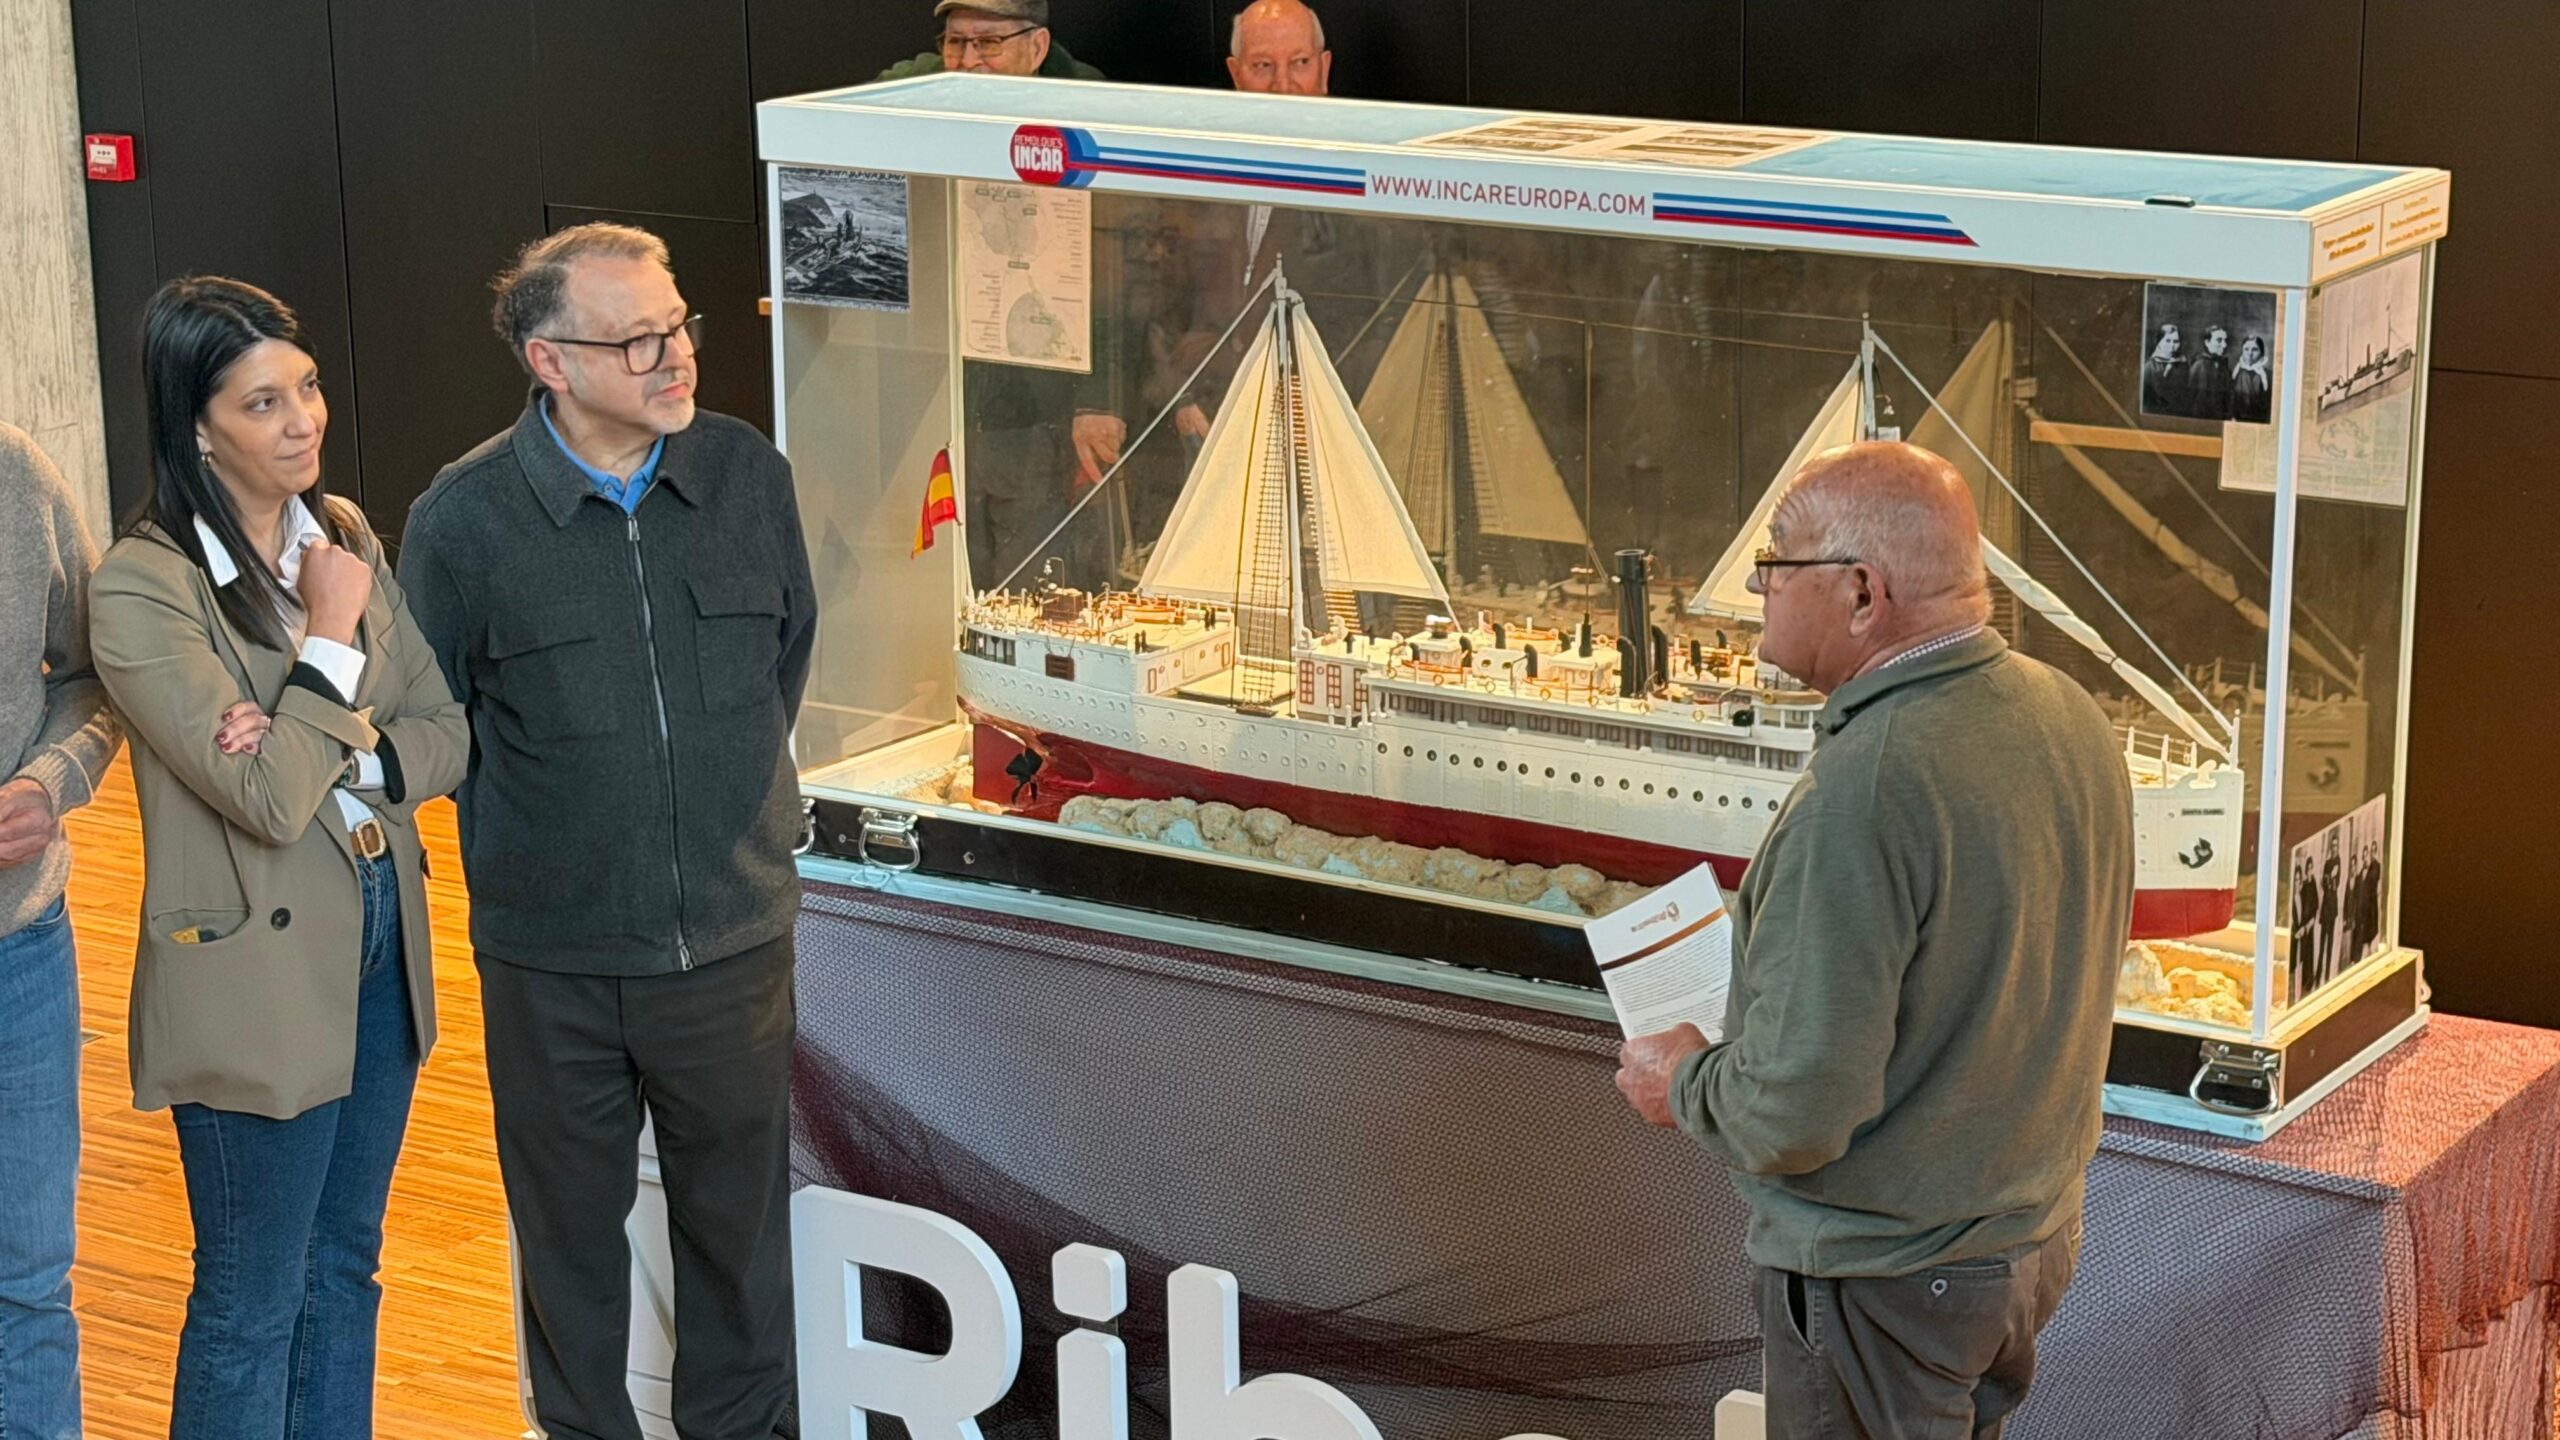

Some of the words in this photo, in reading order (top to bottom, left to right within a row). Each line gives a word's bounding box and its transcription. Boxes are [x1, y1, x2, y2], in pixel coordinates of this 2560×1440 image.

[1014, 134, 1063, 149] REMOLQUES
[1014, 145, 1064, 173] INCAR
[1371, 174, 1646, 216] WWW.INCAREUROPA.COM
